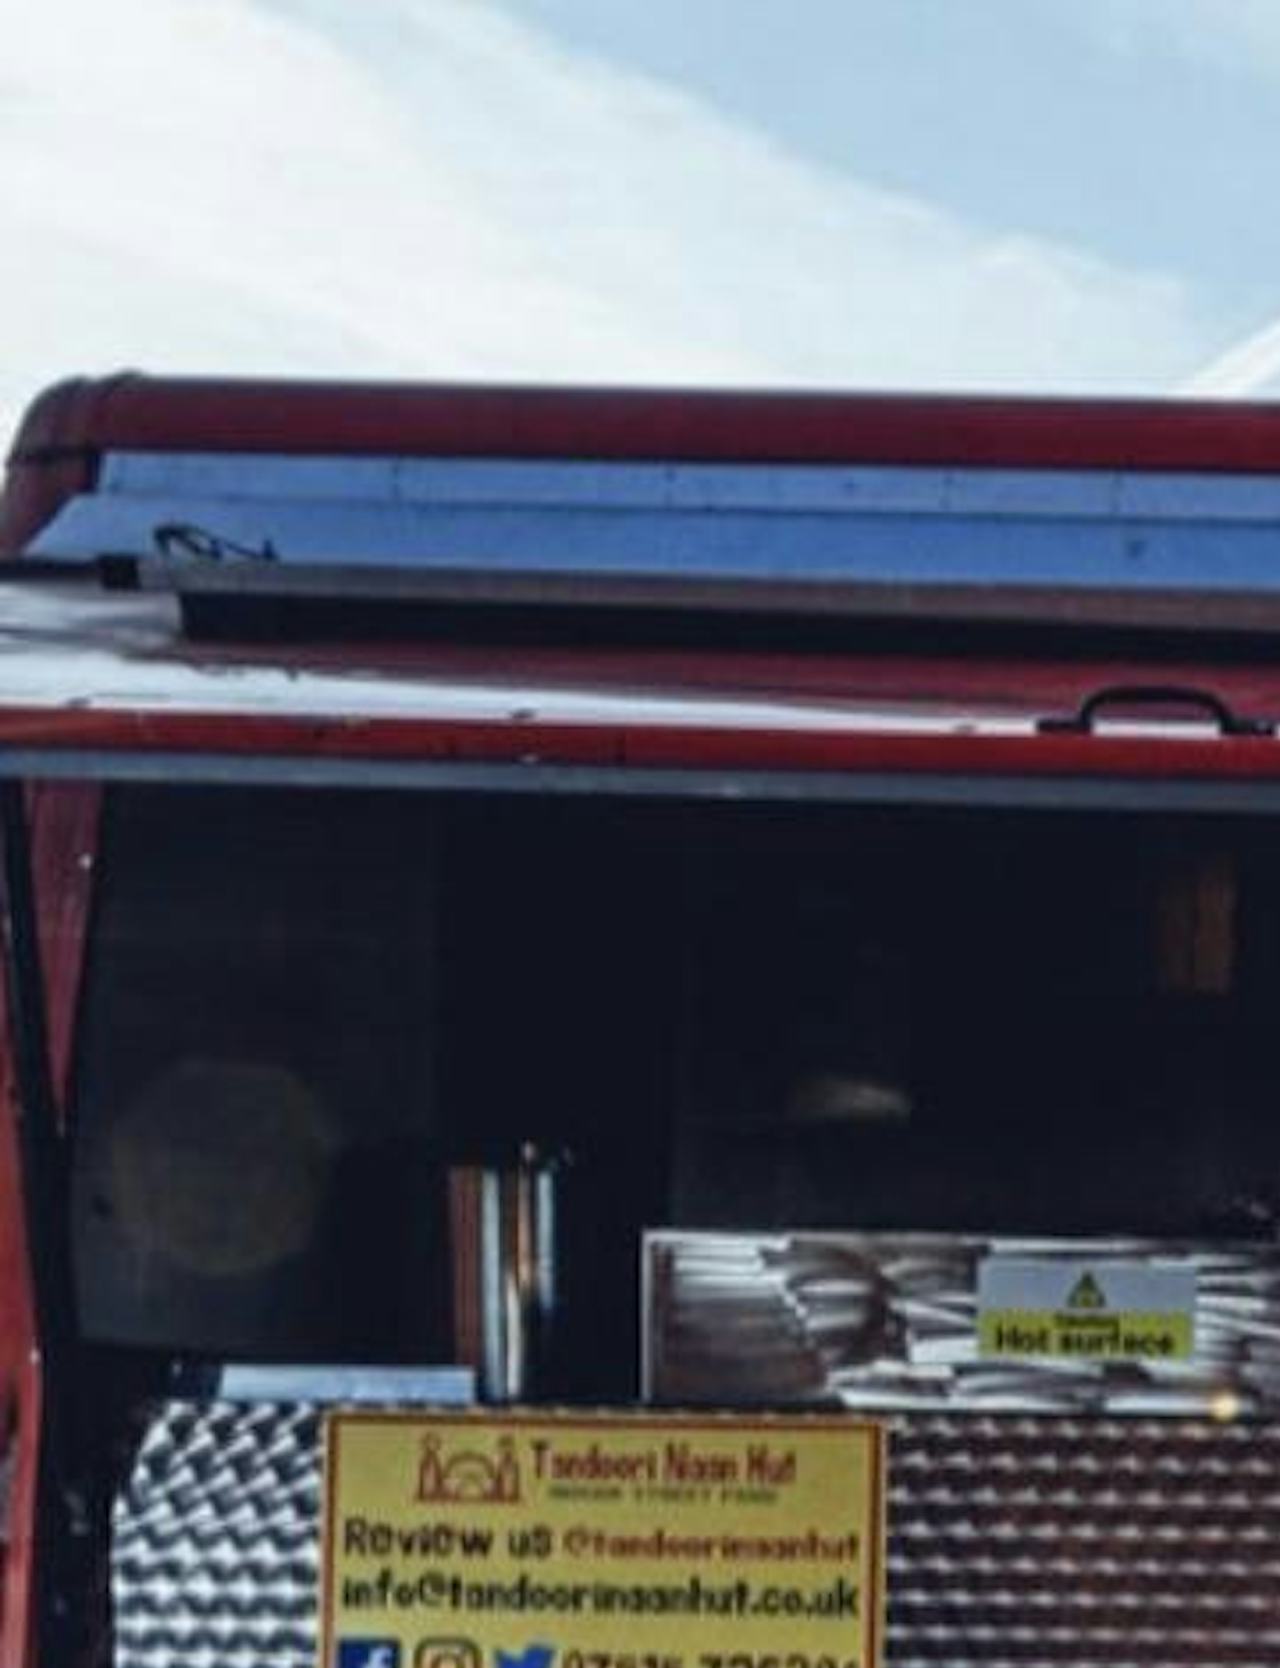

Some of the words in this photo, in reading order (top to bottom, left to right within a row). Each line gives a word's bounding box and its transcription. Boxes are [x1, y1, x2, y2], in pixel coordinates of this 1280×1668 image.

[531, 1441, 655, 1480] Tandoori
[344, 1518, 494, 1558] Review
[507, 1529, 552, 1558] us
[342, 1570, 860, 1618] info@tandoorinaanhut.co.uk
